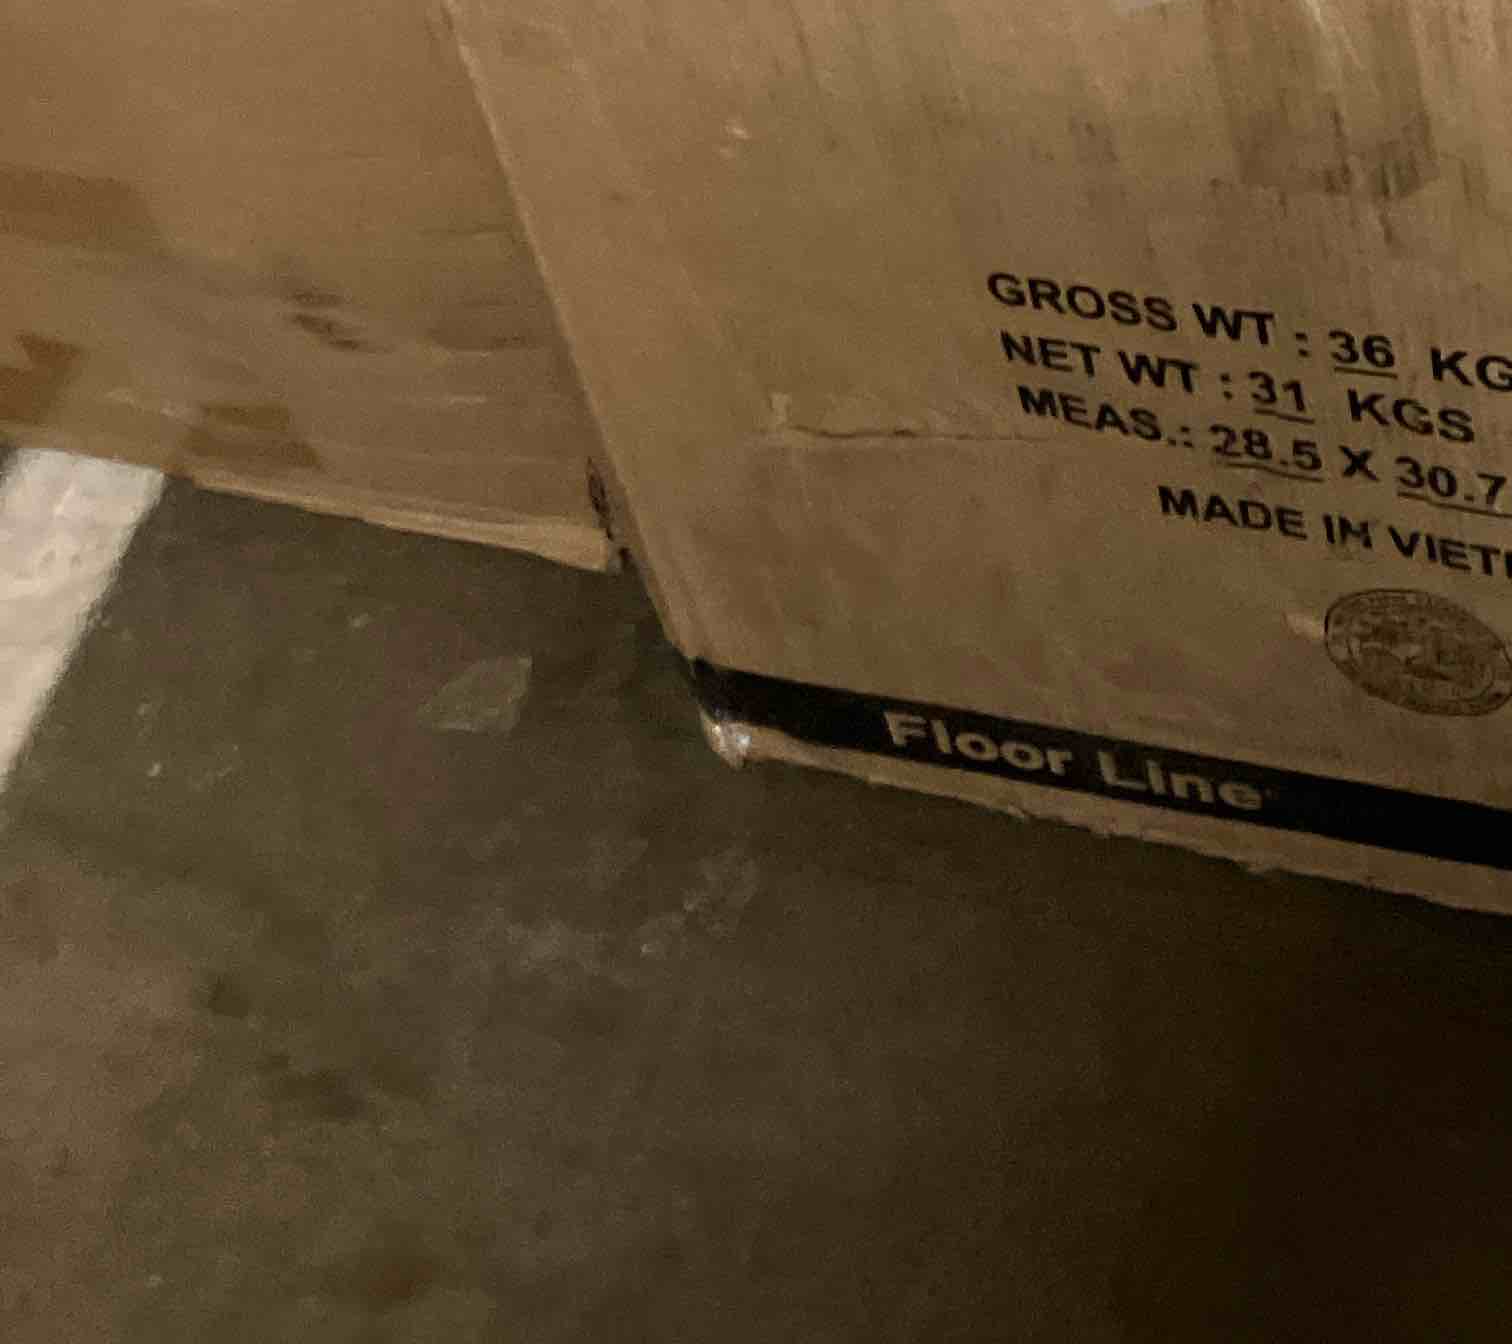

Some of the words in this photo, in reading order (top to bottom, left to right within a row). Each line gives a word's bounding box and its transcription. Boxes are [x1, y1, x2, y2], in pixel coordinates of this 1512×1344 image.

[987, 272, 1178, 334] GROSS
[1192, 302, 1276, 346] WT
[1329, 330, 1398, 369] 36
[1000, 330, 1101, 378] NET
[1117, 350, 1199, 394] WT
[1248, 370, 1307, 413] 31
[1346, 387, 1475, 444] KGS
[1209, 424, 1325, 473] 28.5
[1338, 445, 1380, 483] X
[1157, 484, 1308, 541] MADE
[882, 711, 1074, 775] Floor
[1099, 752, 1264, 811] Line
